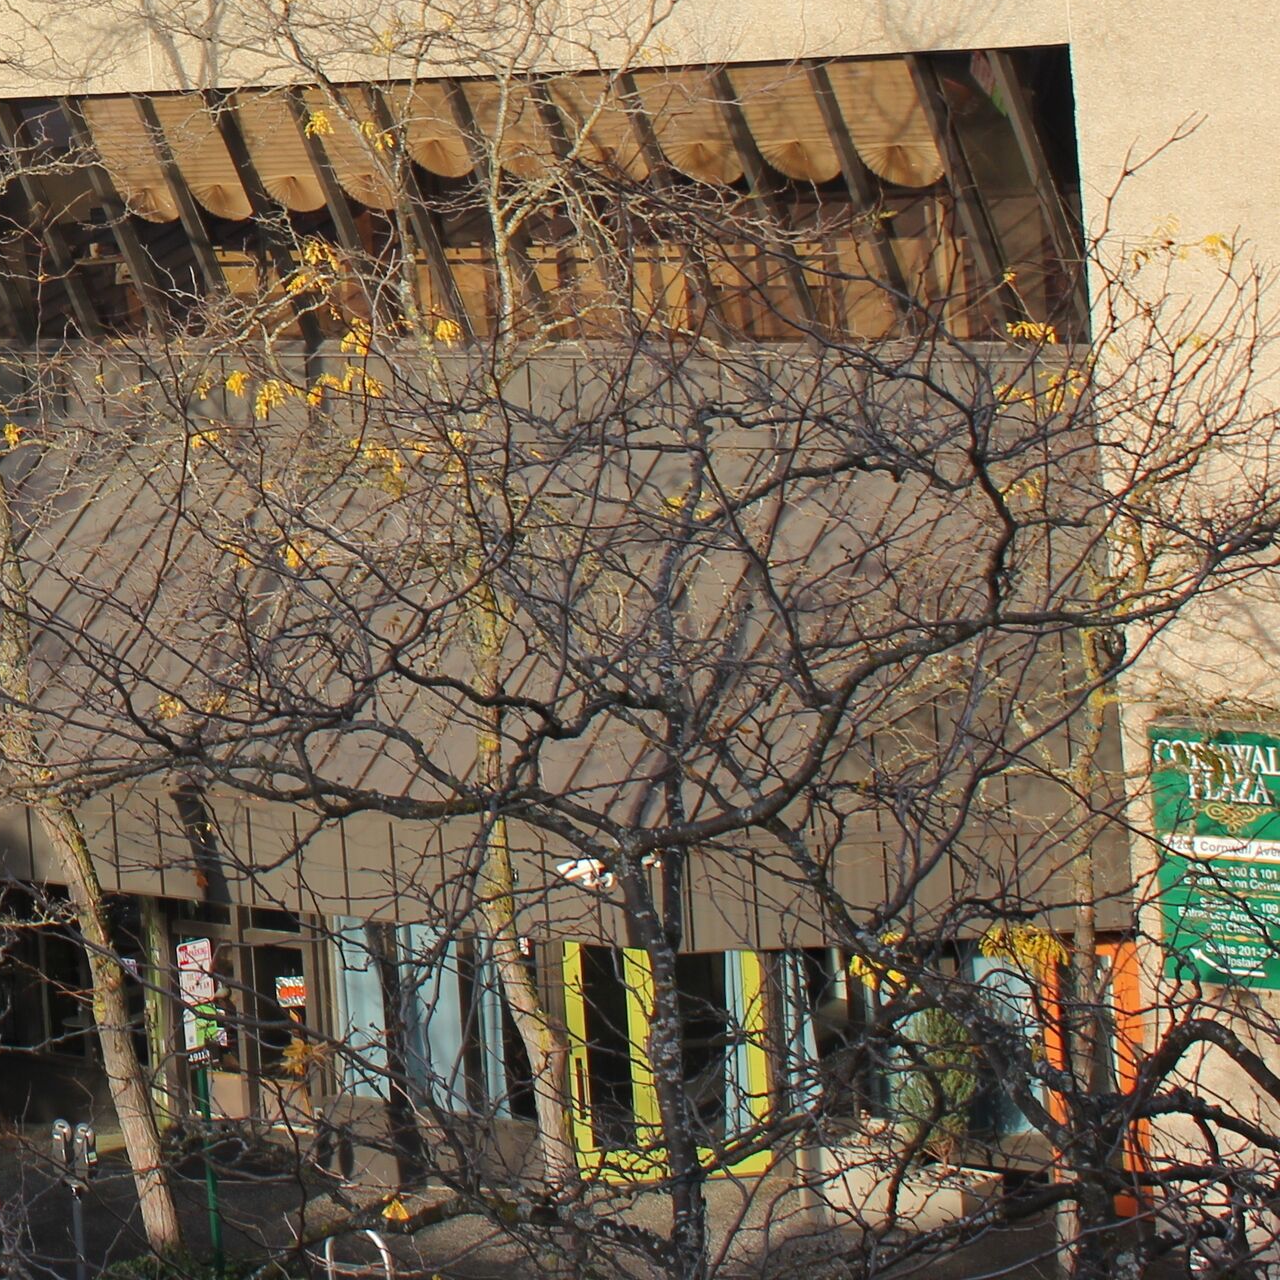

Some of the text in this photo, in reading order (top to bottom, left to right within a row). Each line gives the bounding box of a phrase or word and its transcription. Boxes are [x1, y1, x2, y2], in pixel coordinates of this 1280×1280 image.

[1249, 867, 1258, 878] &
[1260, 869, 1278, 880] 101
[1260, 903, 1278, 915] 109
[279, 986, 306, 999] OPEN
